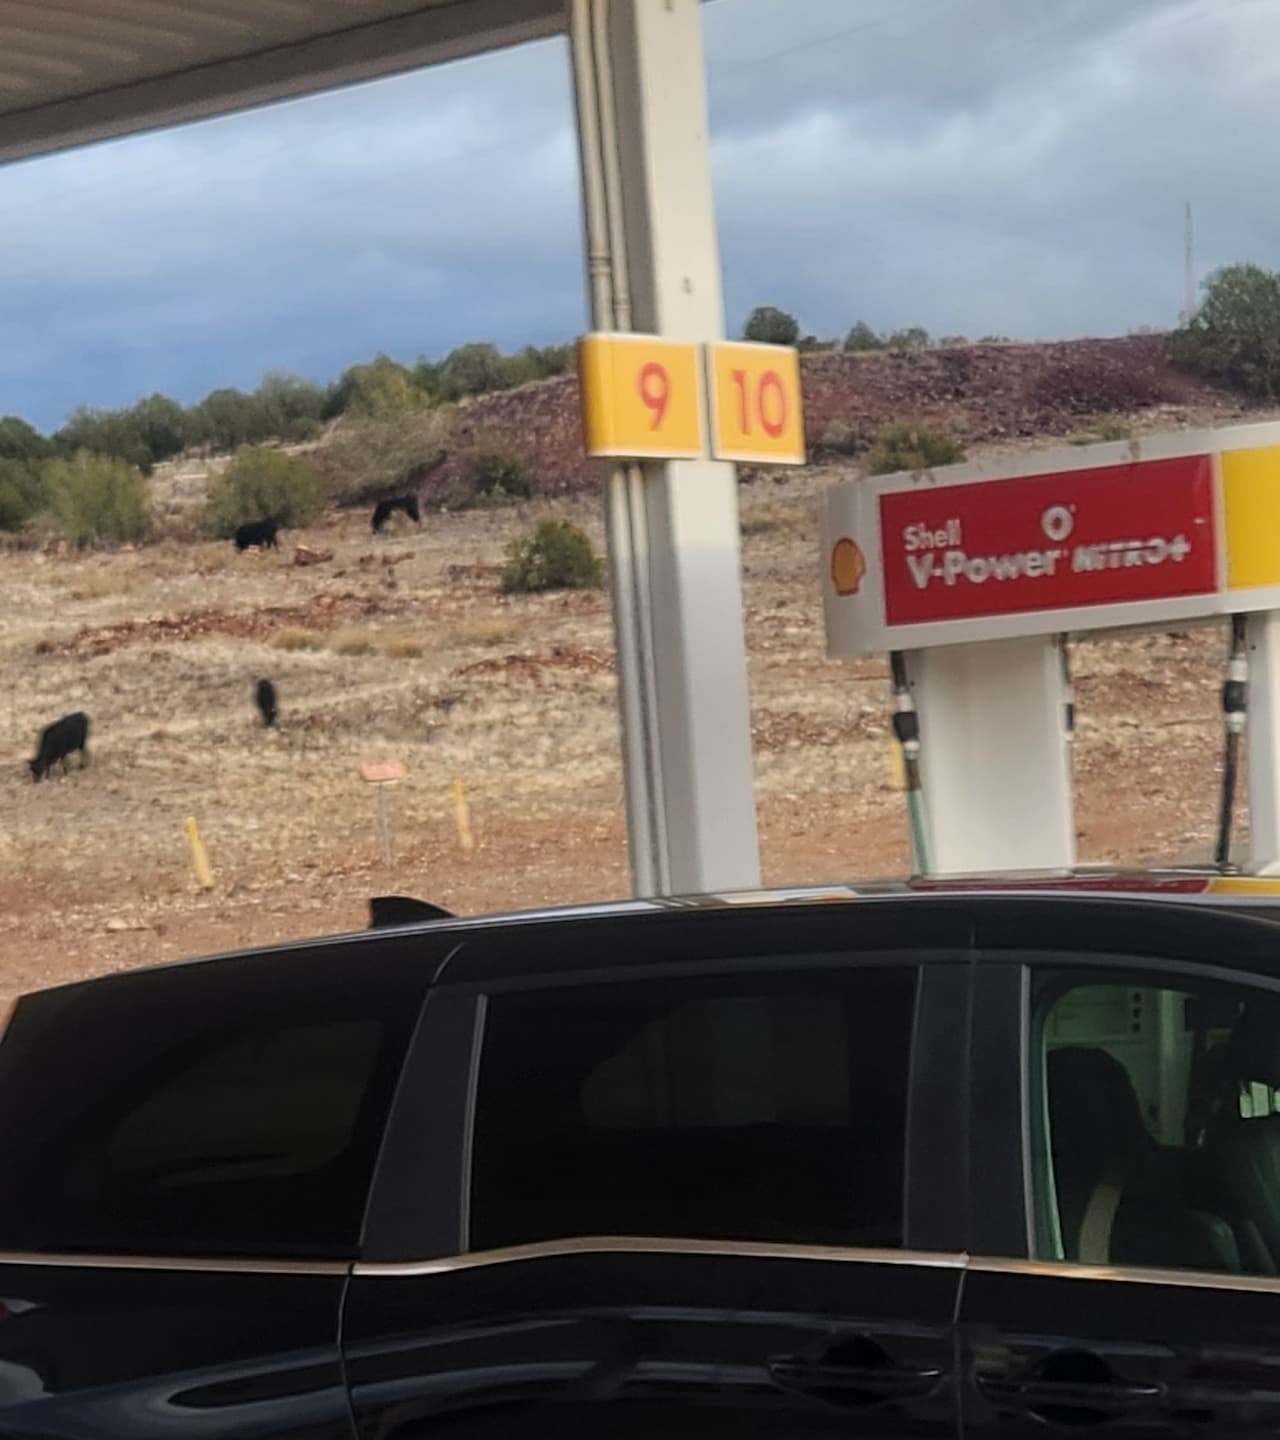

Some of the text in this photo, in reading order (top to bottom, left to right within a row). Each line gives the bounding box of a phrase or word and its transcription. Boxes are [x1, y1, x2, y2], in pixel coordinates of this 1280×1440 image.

[638, 361, 669, 431] 9
[731, 369, 787, 438] 10
[903, 518, 961, 550] Shell
[906, 550, 1062, 589] V-Power
